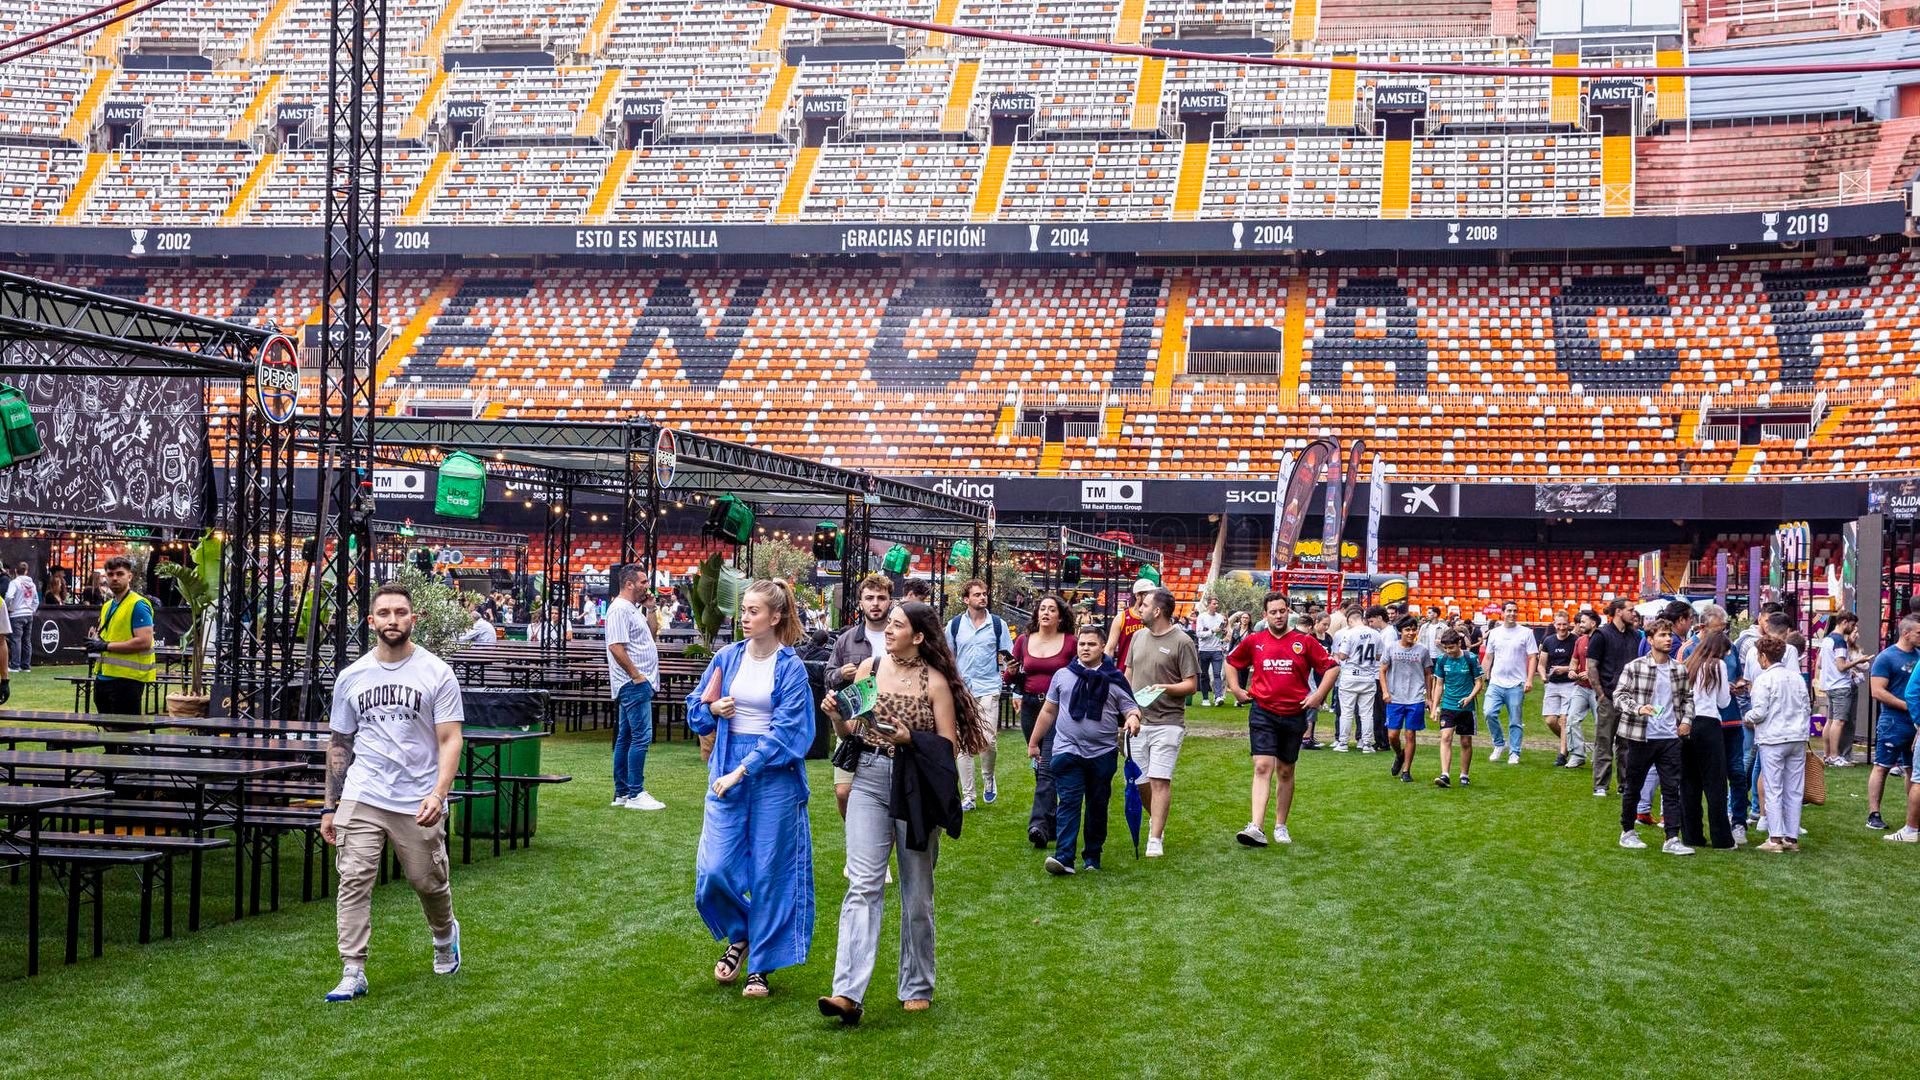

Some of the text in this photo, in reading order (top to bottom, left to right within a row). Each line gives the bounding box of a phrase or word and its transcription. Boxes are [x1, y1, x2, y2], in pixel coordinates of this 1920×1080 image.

[1377, 92, 1425, 104] AMSTEL
[1592, 87, 1639, 99] AMSTEL
[805, 101, 847, 112] AMSTEL
[992, 98, 1036, 110] AMSTEL
[1181, 96, 1226, 108] AMSTEL
[106, 108, 143, 119] AMSTE
[279, 108, 313, 119] AMSTE
[449, 106, 485, 117] AMSTE
[625, 104, 662, 115] AMSTE
[1786, 213, 1829, 235] 2019
[575, 230, 719, 248] ESTO ES MESTALLA
[841, 226, 986, 249] ¡GRACIAS AFICIÓN!
[1050, 229, 1090, 246] 2004
[1253, 226, 1294, 244] 2004
[1465, 226, 1498, 241] 2008
[157, 232, 192, 250] 2002
[394, 232, 431, 249] 2004
[261, 367, 299, 391] PEPSI
[64, 474, 84, 497] COOL
[374, 476, 392, 487] TM
[446, 487, 470, 497] Uber
[932, 479, 994, 498] divina
[1086, 486, 1106, 498] TM
[446, 496, 470, 506] Eats
[1124, 503, 1142, 511] Group
[1125, 623, 1145, 636] CLEVE
[42, 632, 59, 641] PEPSI
[1355, 643, 1376, 665] 14
[357, 684, 423, 716] BROOKLYN
[365, 712, 418, 722] NEW YORK
